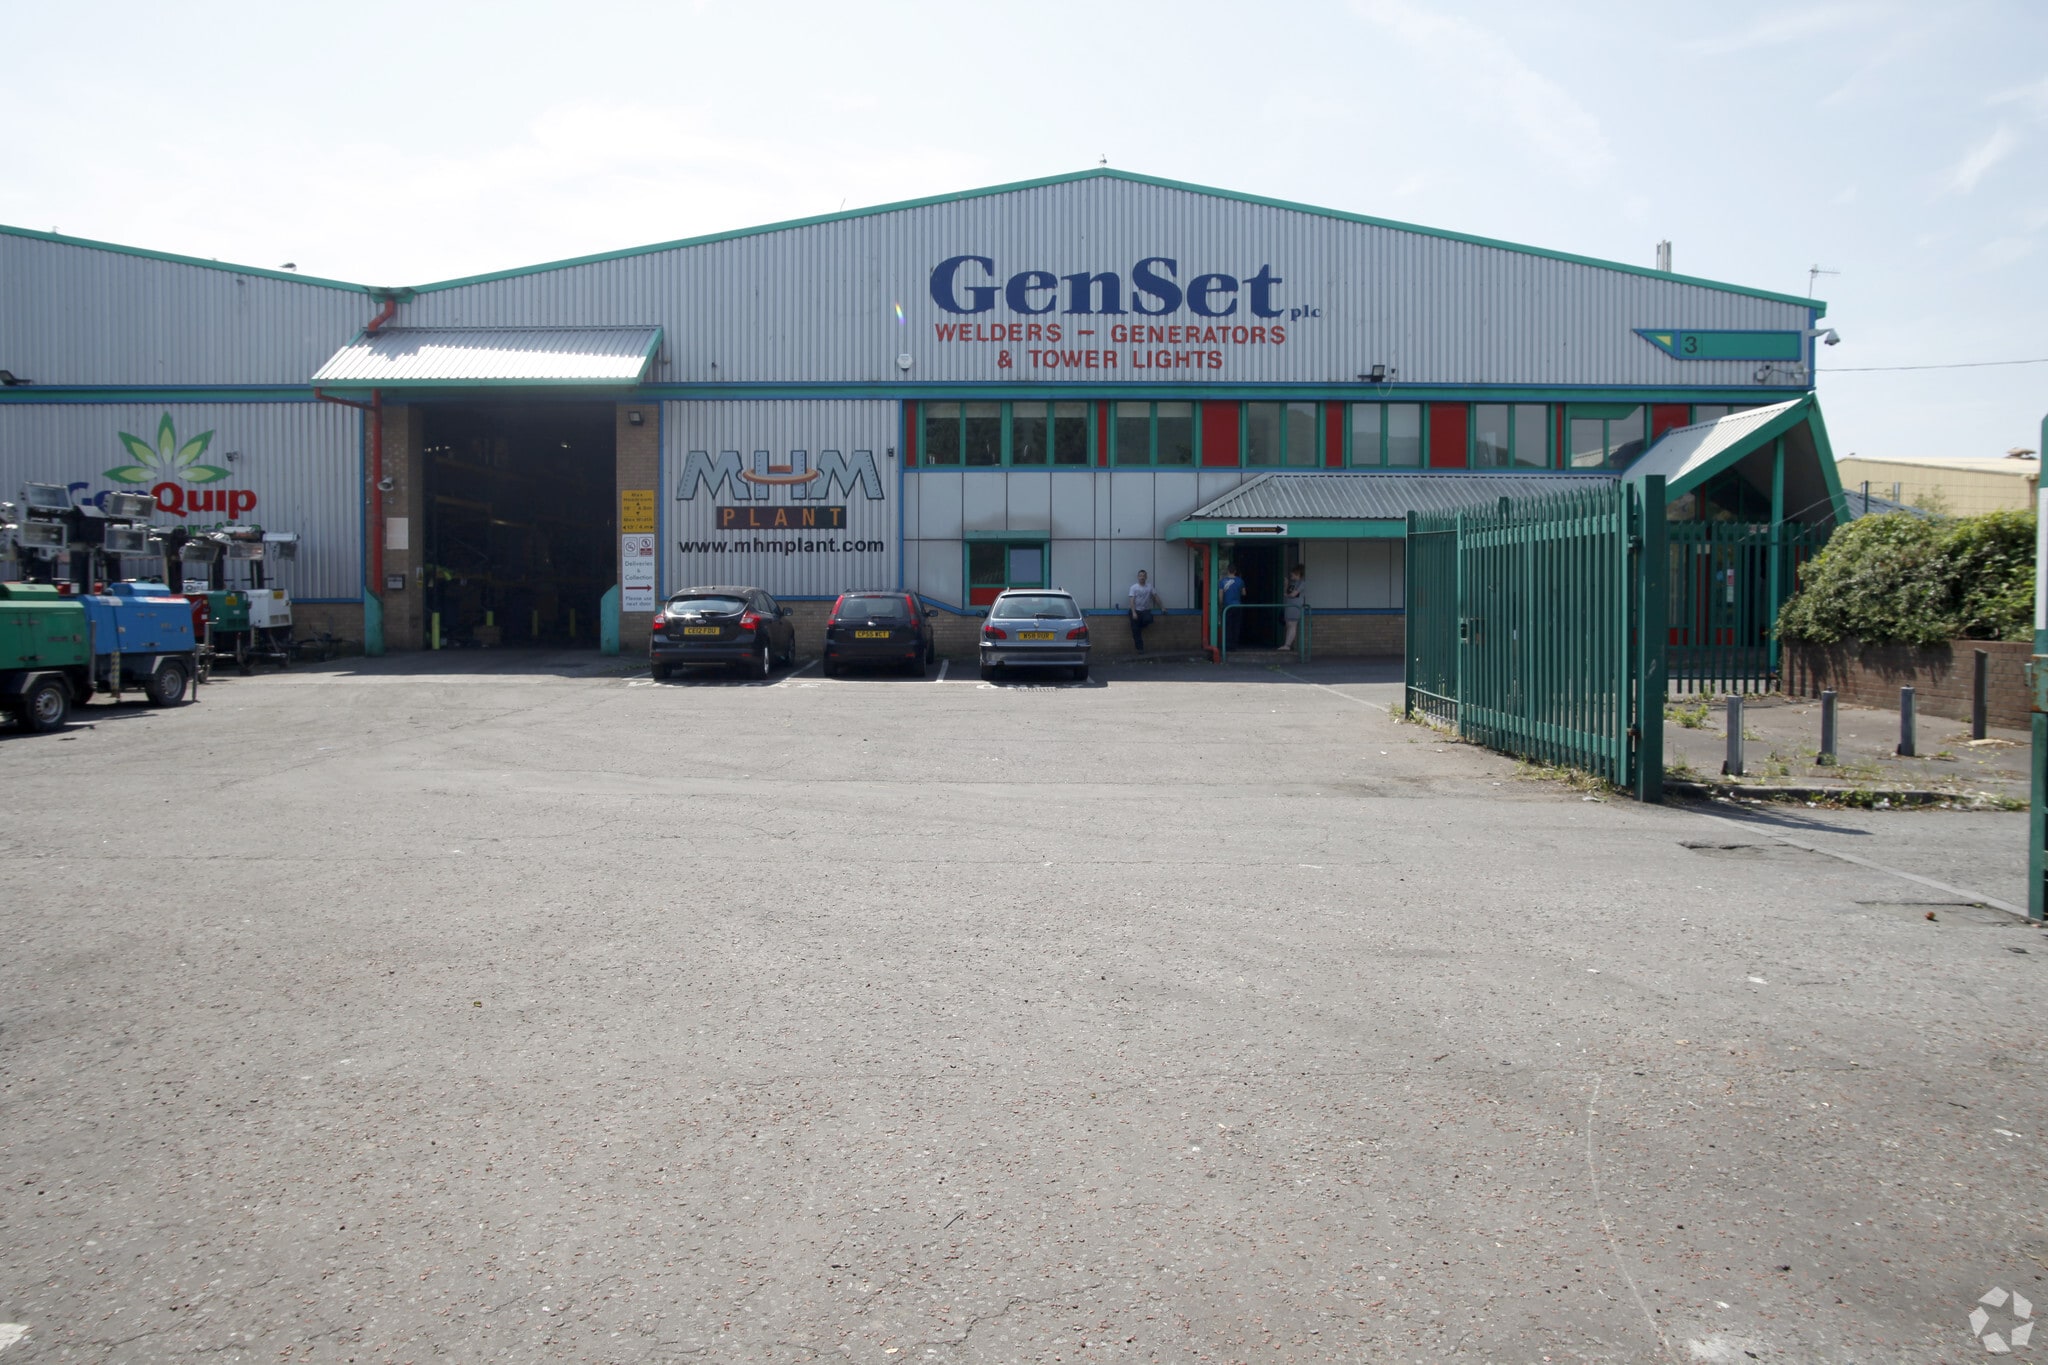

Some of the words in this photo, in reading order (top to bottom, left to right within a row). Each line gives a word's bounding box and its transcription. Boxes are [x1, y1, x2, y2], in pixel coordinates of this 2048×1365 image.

[929, 255, 1285, 318] GenSet
[1290, 304, 1321, 321] plc
[935, 323, 1062, 343] WELDERS
[1110, 325, 1286, 345] GENERATORS
[1684, 336, 1698, 354] 3
[997, 350, 1013, 368] &
[1029, 349, 1118, 369] TOWER
[1133, 350, 1223, 370] LIGHTS
[676, 450, 885, 501] MHM
[723, 507, 842, 527] PLANT
[678, 536, 885, 556] www.mhmplant.com
